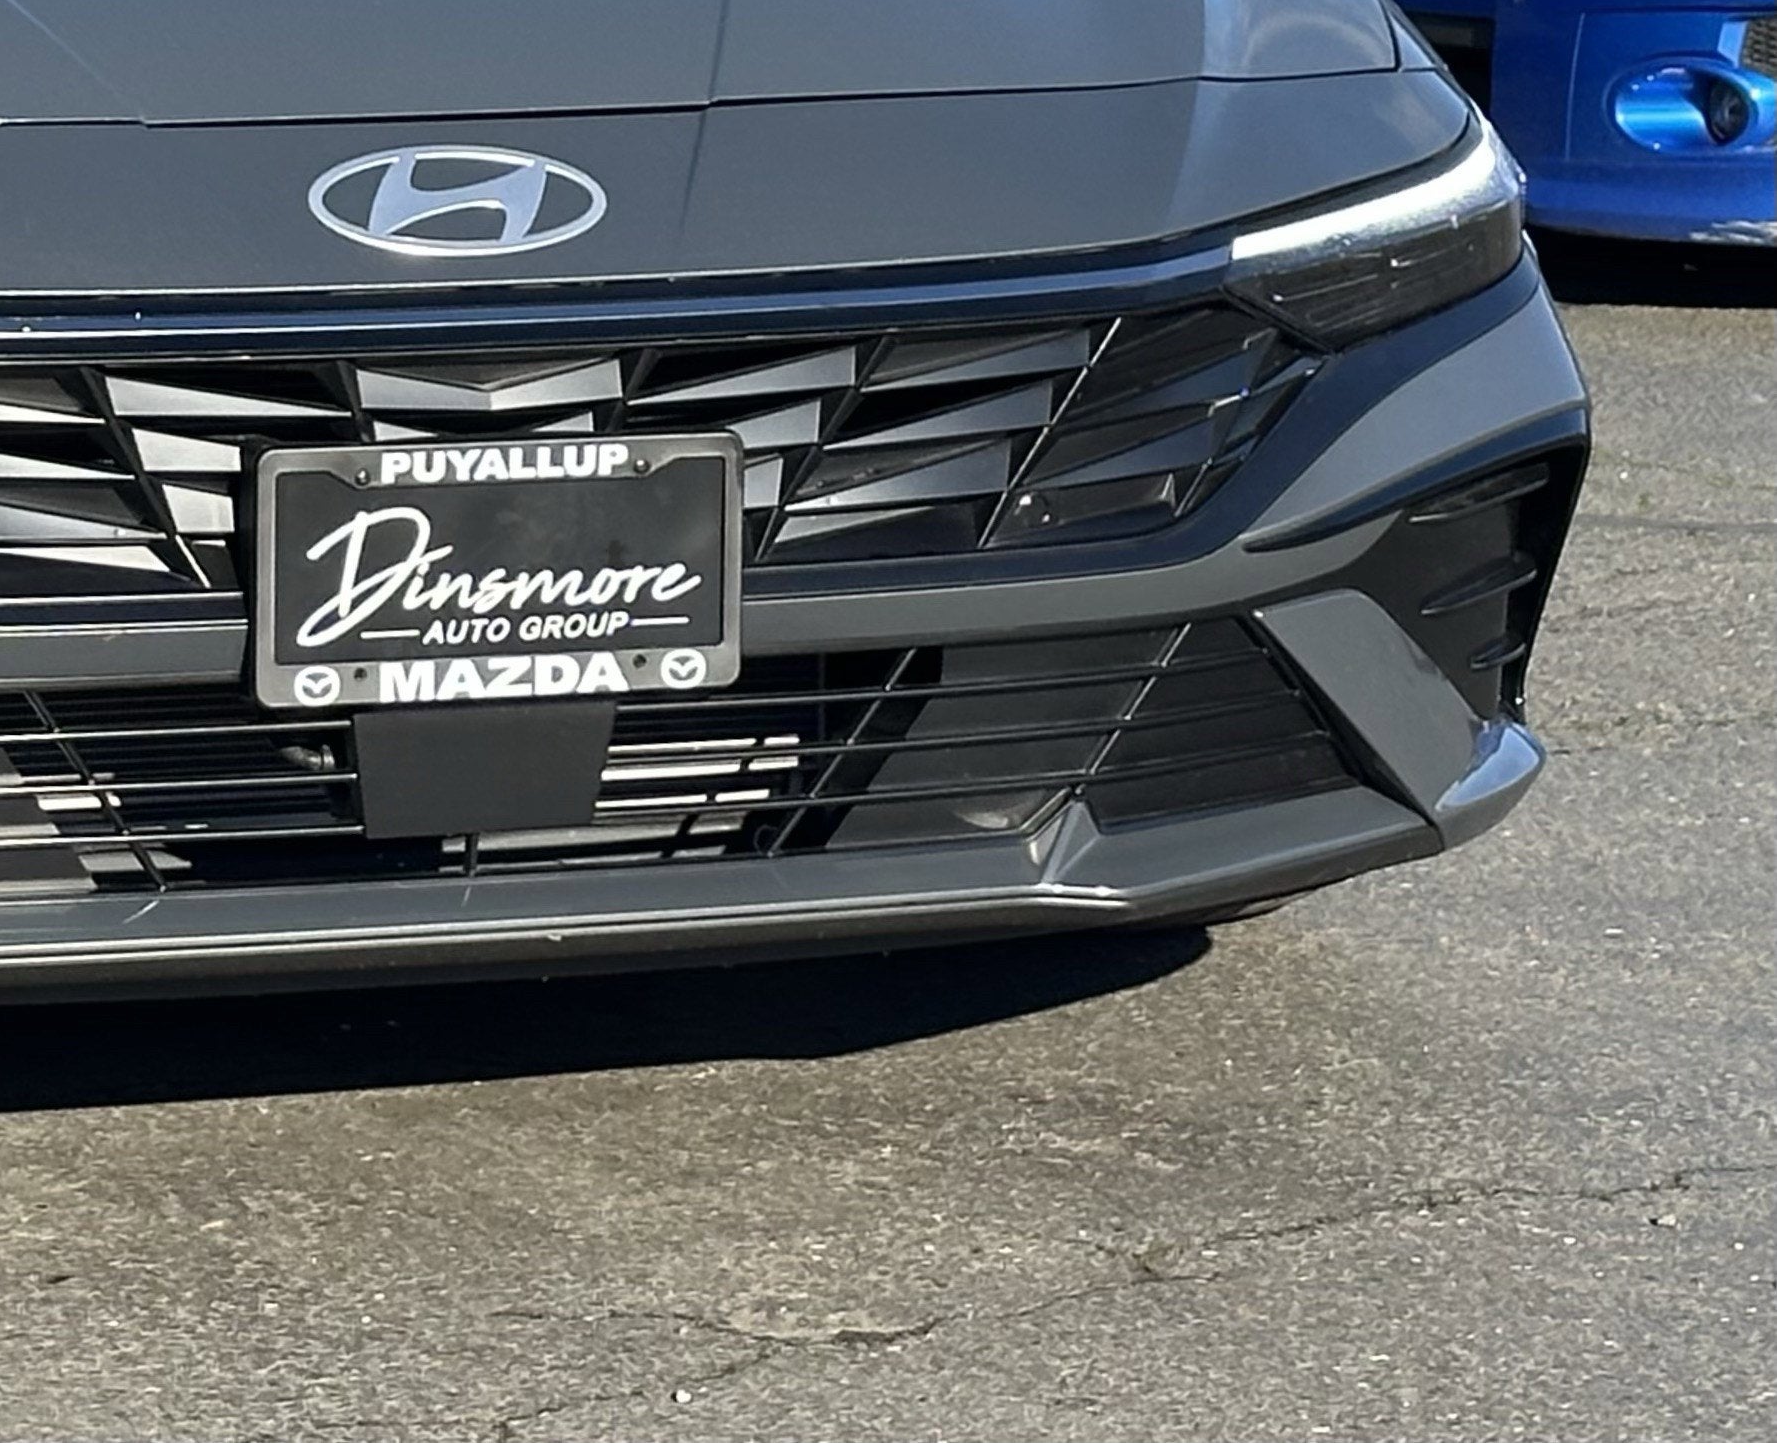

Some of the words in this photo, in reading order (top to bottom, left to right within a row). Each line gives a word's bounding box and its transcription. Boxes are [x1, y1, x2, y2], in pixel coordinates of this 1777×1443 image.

[380, 443, 629, 484] PUYALLUP
[296, 506, 702, 648] Dinsmore
[422, 618, 508, 645] AUTO
[519, 611, 630, 641] GROUP
[378, 652, 630, 703] MAZDA
